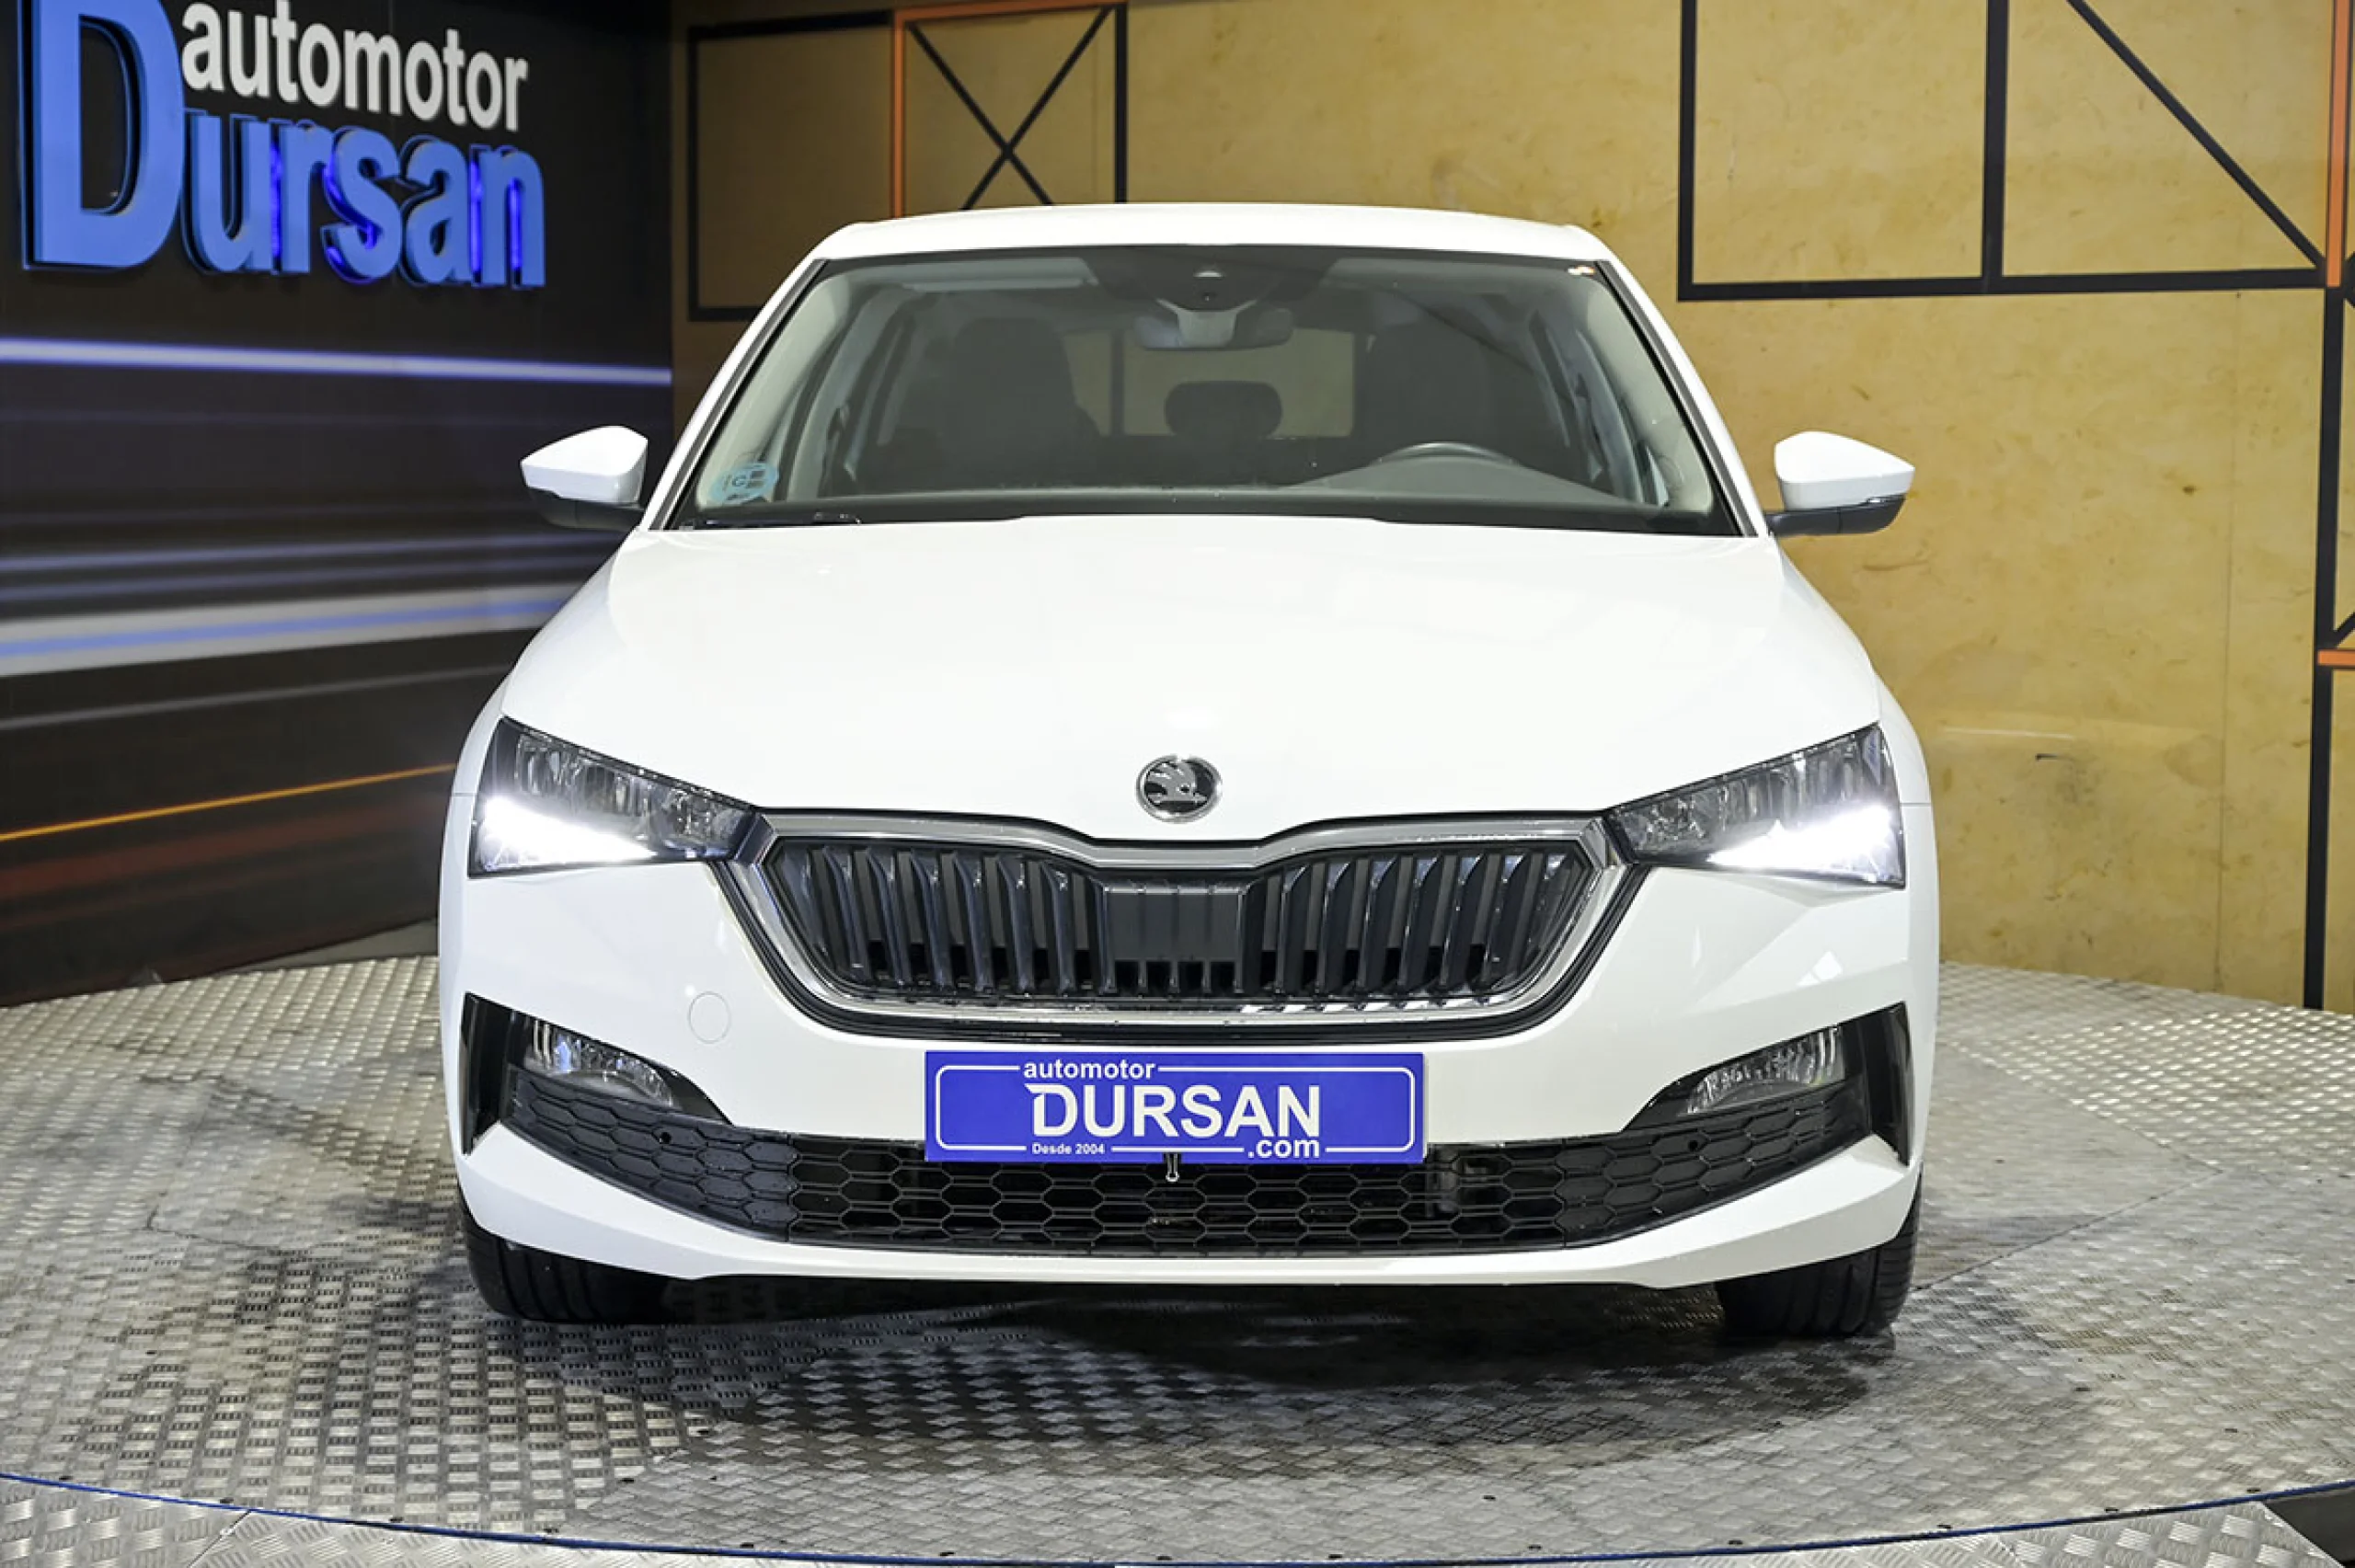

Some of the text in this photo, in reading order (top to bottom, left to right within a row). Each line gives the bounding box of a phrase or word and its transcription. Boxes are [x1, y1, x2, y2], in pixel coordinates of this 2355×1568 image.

[181, 1, 527, 131] automotor
[18, 0, 546, 289] Dursan
[1024, 1059, 1155, 1080] automotor
[1025, 1083, 1321, 1138] DURSAN
[1032, 1143, 1106, 1155] Desde 2004
[1247, 1138, 1321, 1159] .com
